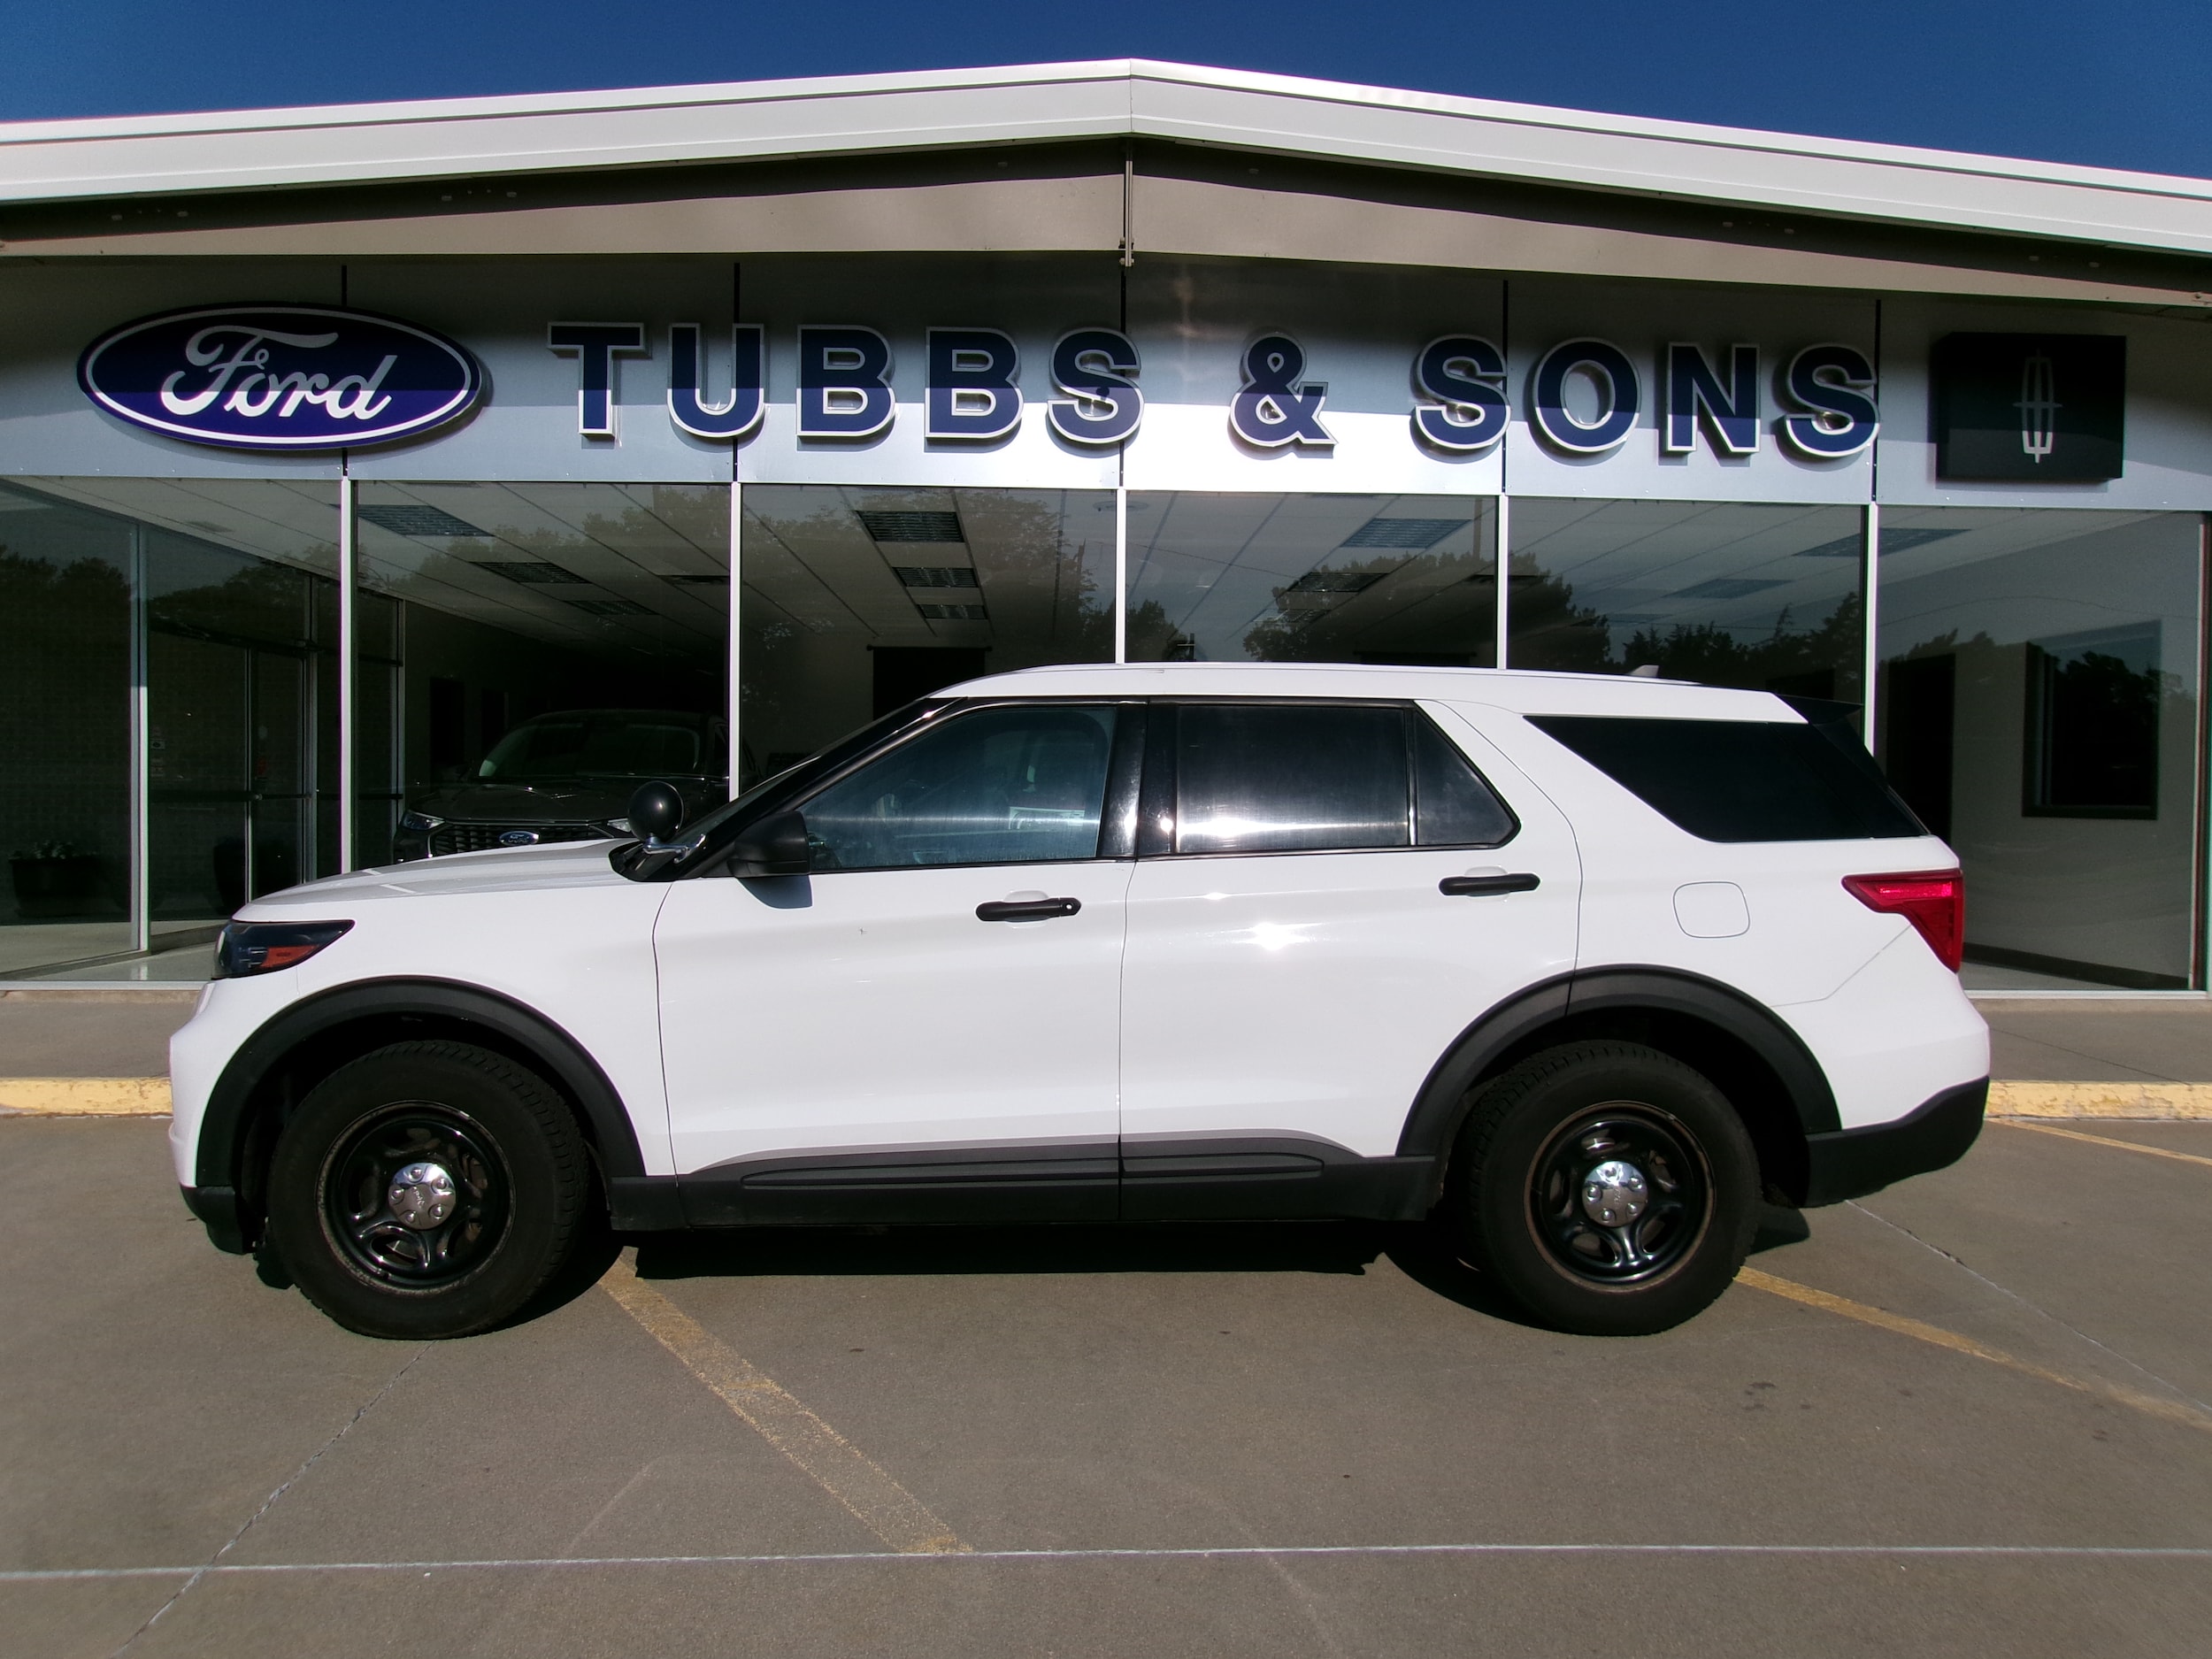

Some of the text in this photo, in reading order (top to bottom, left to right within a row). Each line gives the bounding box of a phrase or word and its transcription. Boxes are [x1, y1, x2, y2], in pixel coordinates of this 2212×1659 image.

[160, 325, 398, 421] Ford
[547, 321, 1880, 457] TUBBS & SONS
